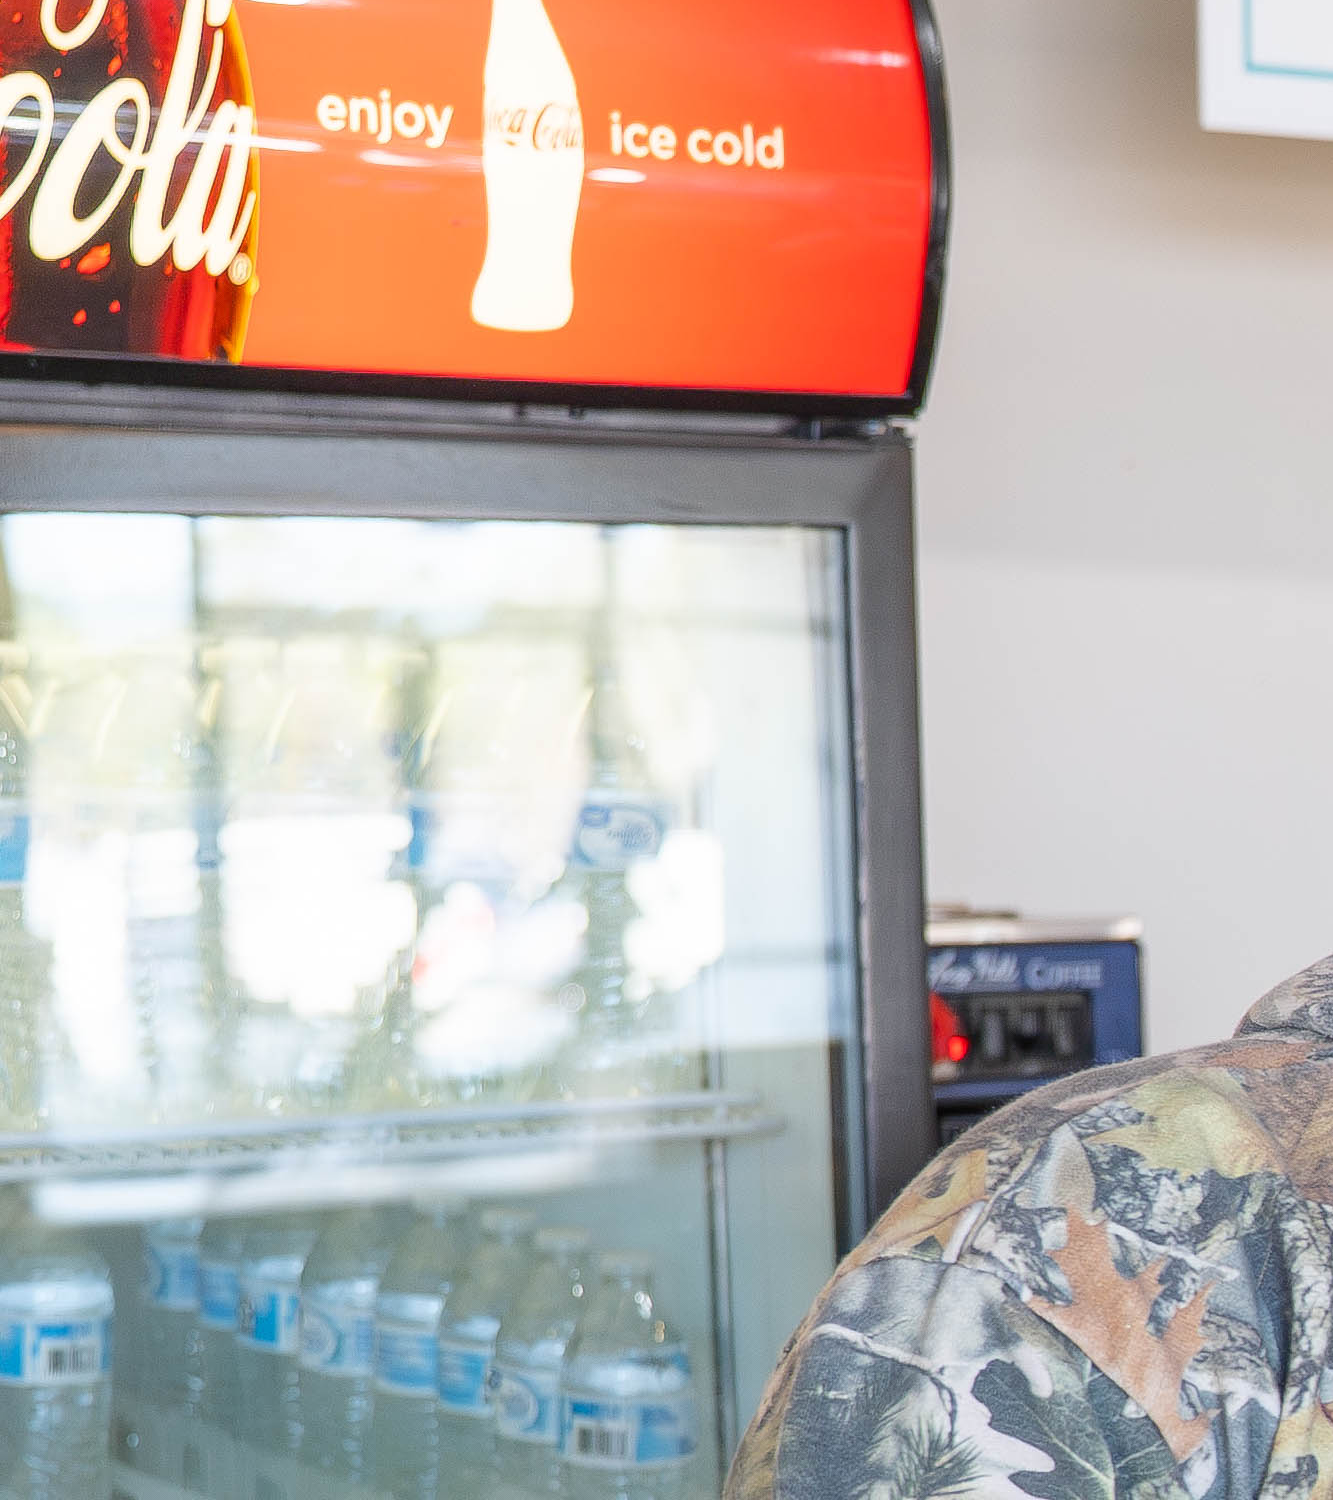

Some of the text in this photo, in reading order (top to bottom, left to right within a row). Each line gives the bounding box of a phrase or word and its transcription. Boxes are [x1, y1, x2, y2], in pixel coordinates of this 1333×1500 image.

[315, 90, 785, 170] enjoy ice cold
